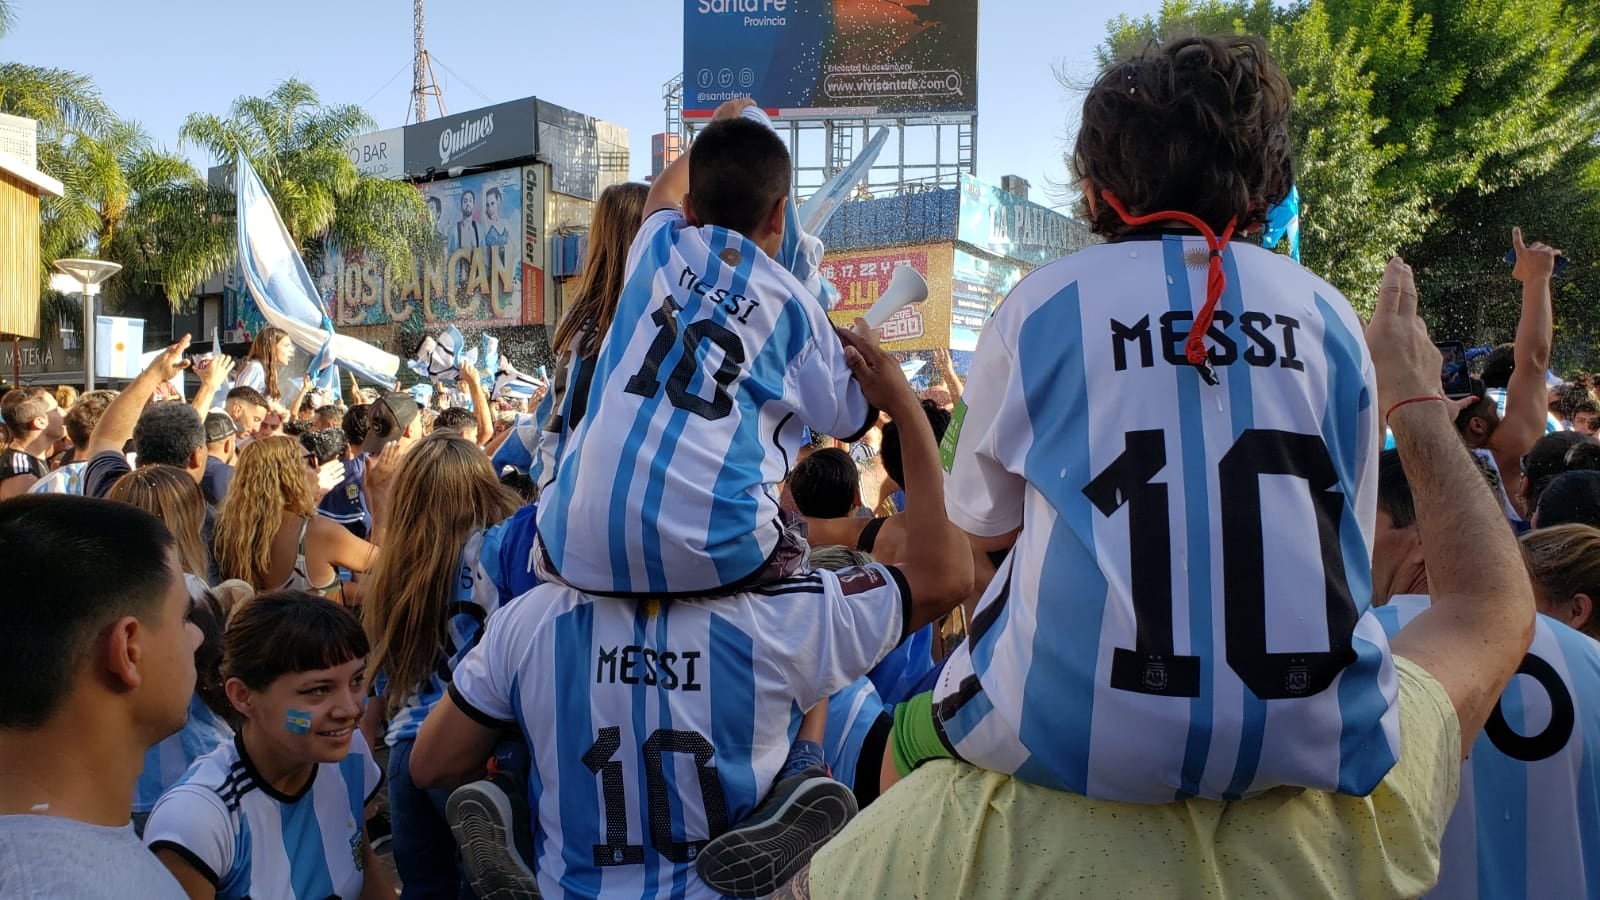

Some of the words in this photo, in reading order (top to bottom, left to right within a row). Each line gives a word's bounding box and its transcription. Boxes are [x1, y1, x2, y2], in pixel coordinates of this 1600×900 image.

[744, 16, 787, 26] Provincia
[698, 91, 752, 103] @santafetur
[828, 78, 945, 92] www.vivisantafe.com
[363, 141, 388, 163] BAR
[438, 112, 494, 166] Quilmes
[526, 169, 537, 264] Chevallier
[678, 266, 760, 325] MESSI
[860, 262, 878, 277] 22
[623, 294, 745, 421] 10
[1110, 310, 1304, 372] MESSI
[1081, 428, 1358, 700] 10
[596, 645, 701, 691] MESSI
[581, 726, 729, 867] 10
